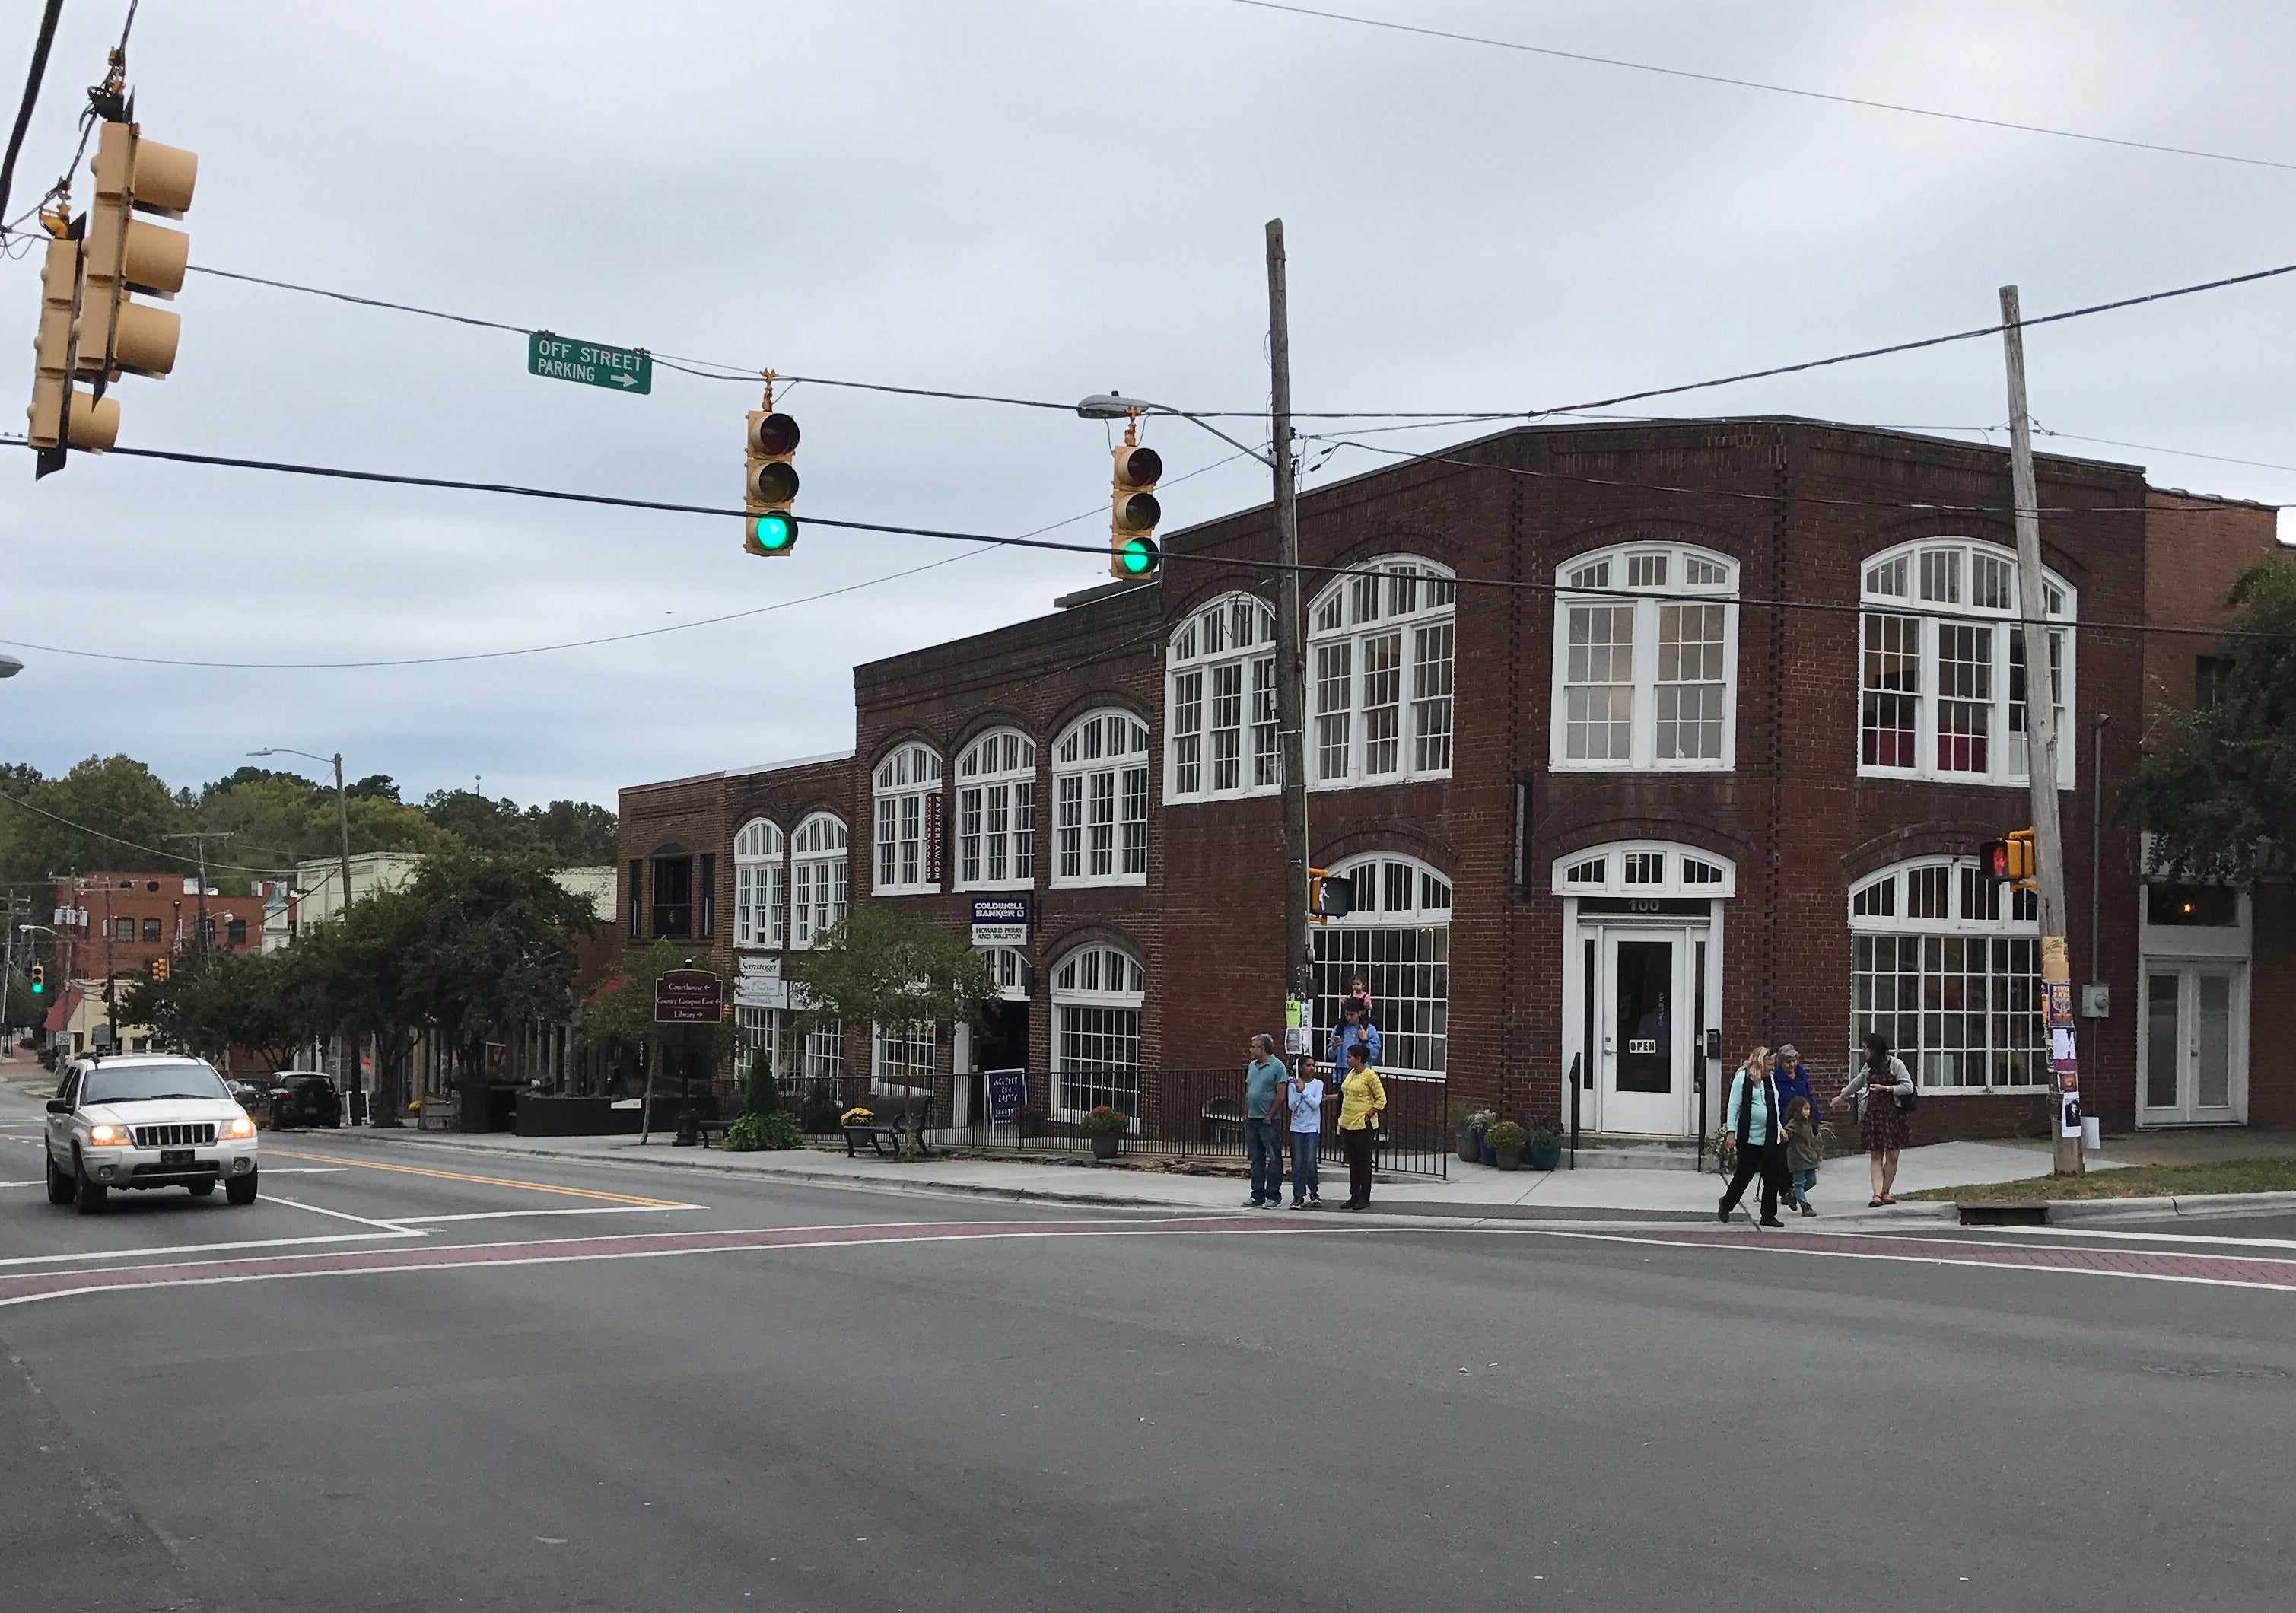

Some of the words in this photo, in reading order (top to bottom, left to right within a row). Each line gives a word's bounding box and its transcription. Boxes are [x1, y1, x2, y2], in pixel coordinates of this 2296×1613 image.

[539, 339, 572, 359] OFF
[580, 347, 643, 372] STREET
[537, 358, 596, 382] PARKING
[1628, 899, 1660, 911] 100
[975, 909, 1015, 918] BANKER
[743, 962, 777, 972] Saratoga
[657, 997, 677, 1005] County
[674, 1010, 696, 1019] Library
[1630, 1042, 1655, 1051] OPEN
[994, 1077, 1018, 1086] AGENT
